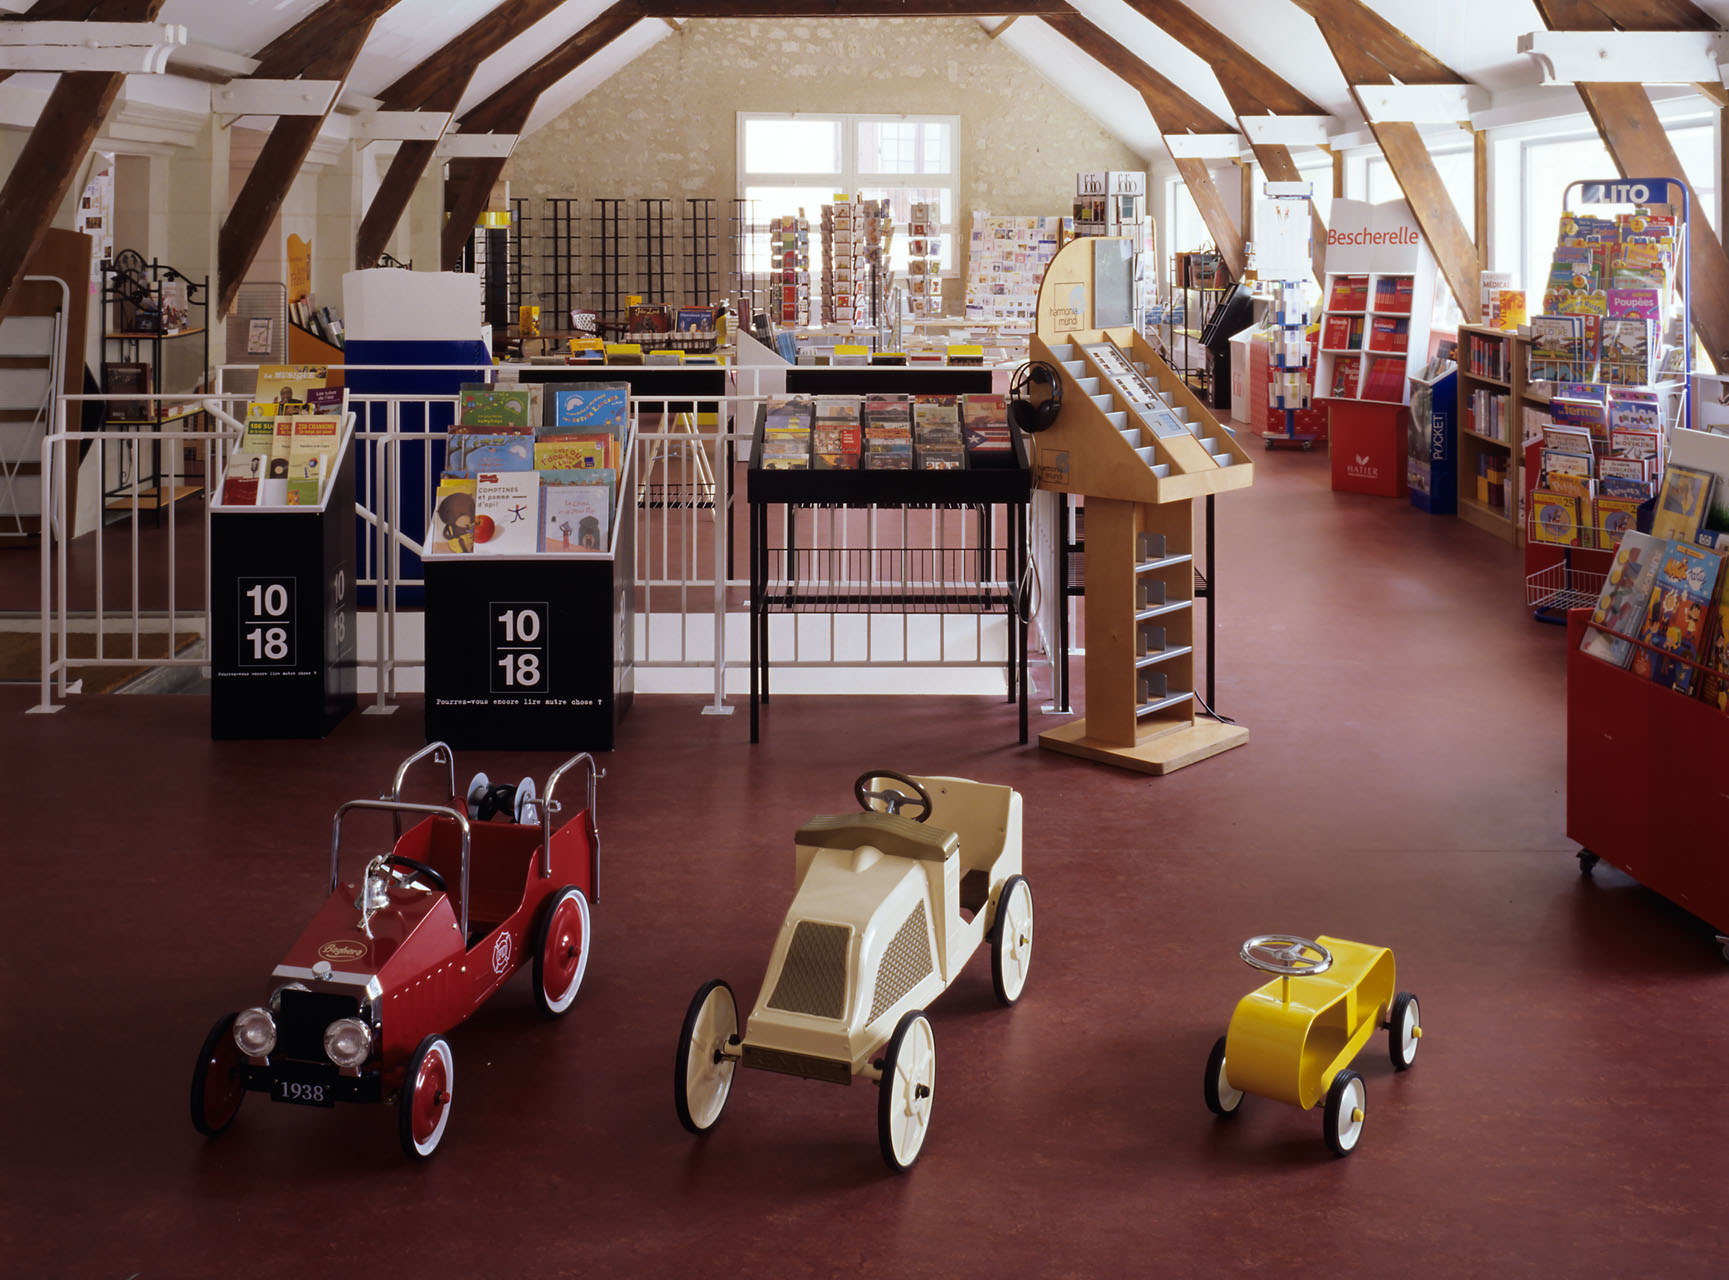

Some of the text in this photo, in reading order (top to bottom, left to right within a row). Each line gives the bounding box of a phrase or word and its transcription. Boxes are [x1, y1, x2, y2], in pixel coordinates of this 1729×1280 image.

[1598, 183, 1650, 204] LITO
[1327, 226, 1419, 246] Bescherelle
[1432, 414, 1444, 460] POCKET
[1347, 464, 1379, 476] HATIER
[246, 584, 288, 616] 10
[498, 609, 540, 642] 10
[246, 627, 289, 659] 18
[498, 653, 541, 686] 18
[436, 698, 489, 706] Pourrez-vous
[571, 698, 594, 706] chose
[281, 1081, 325, 1102] 1938
